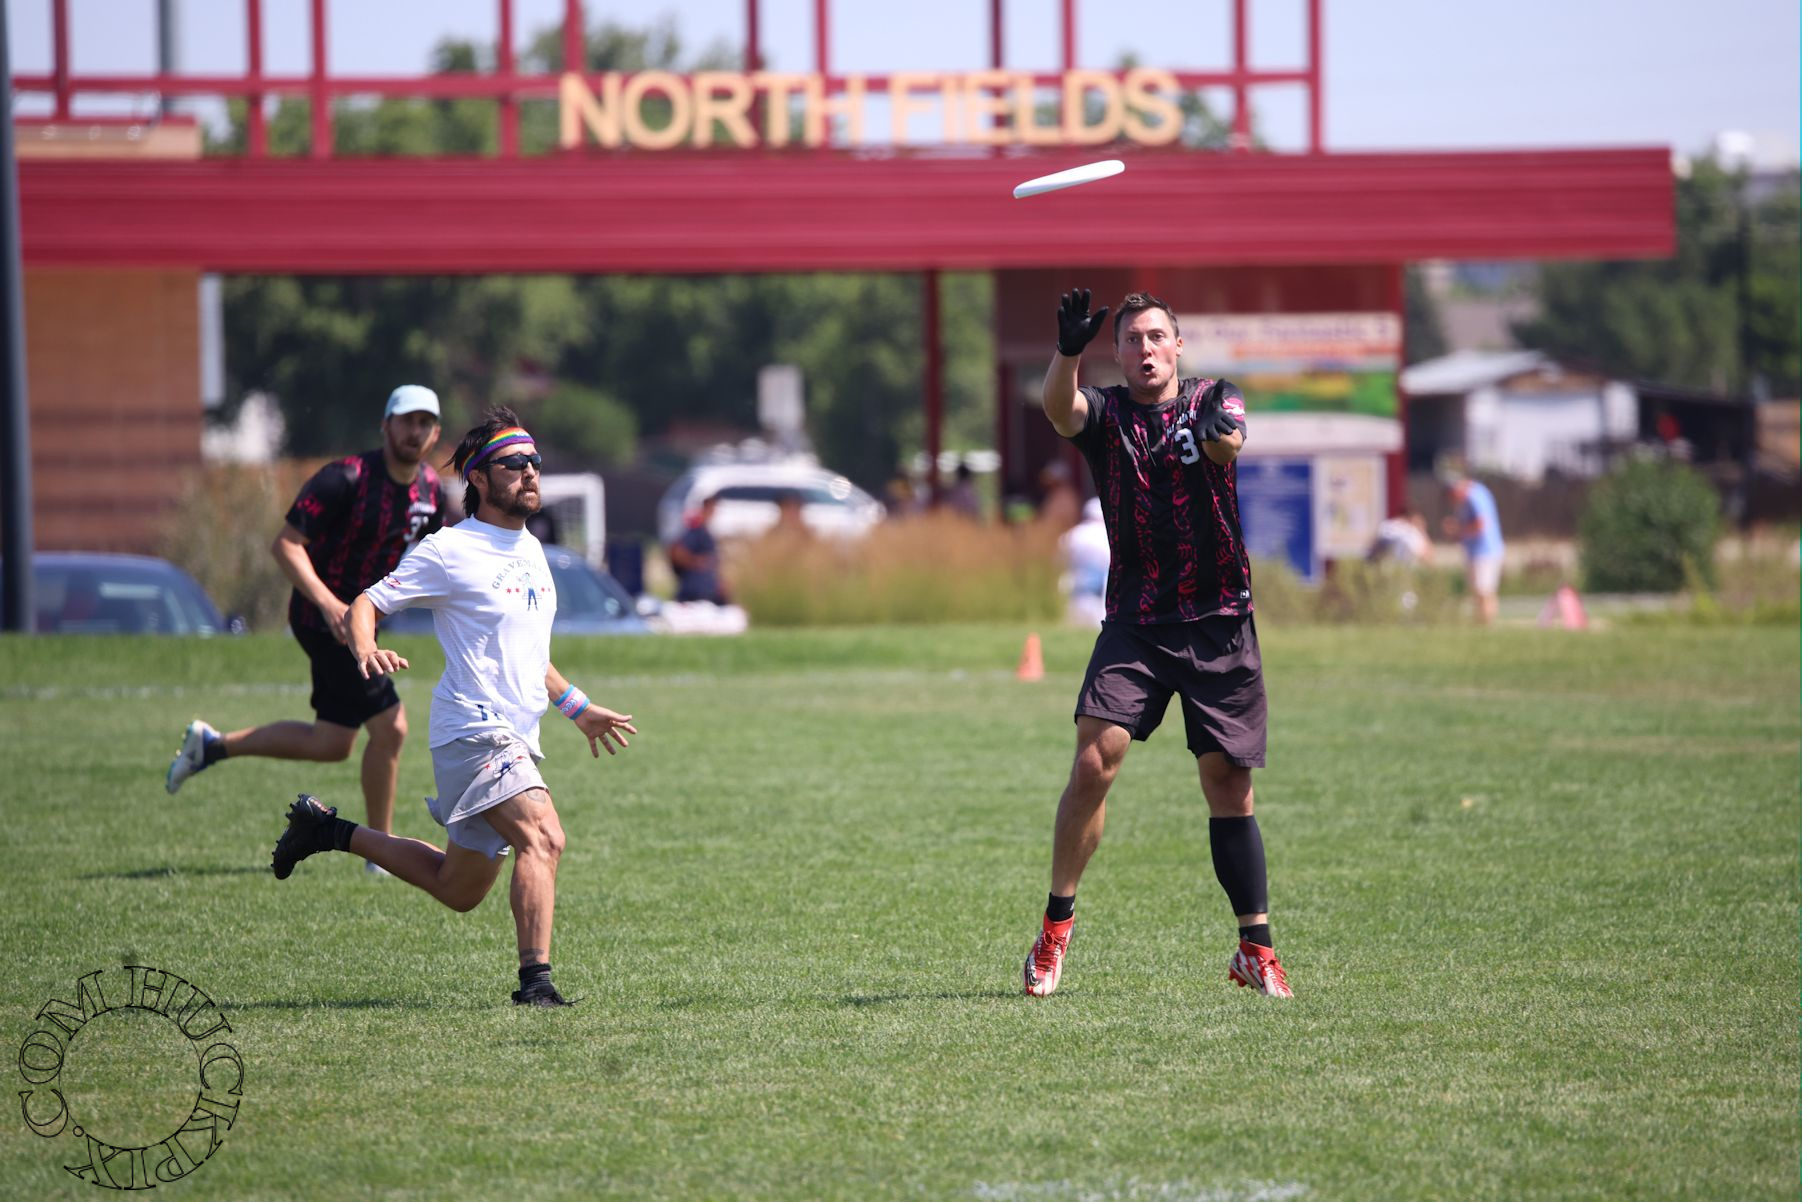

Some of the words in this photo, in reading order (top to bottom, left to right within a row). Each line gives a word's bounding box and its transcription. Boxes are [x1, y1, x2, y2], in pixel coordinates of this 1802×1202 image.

[559, 70, 867, 149] NORTH
[889, 68, 1184, 146] FIELDS
[1174, 428, 1200, 465] 3
